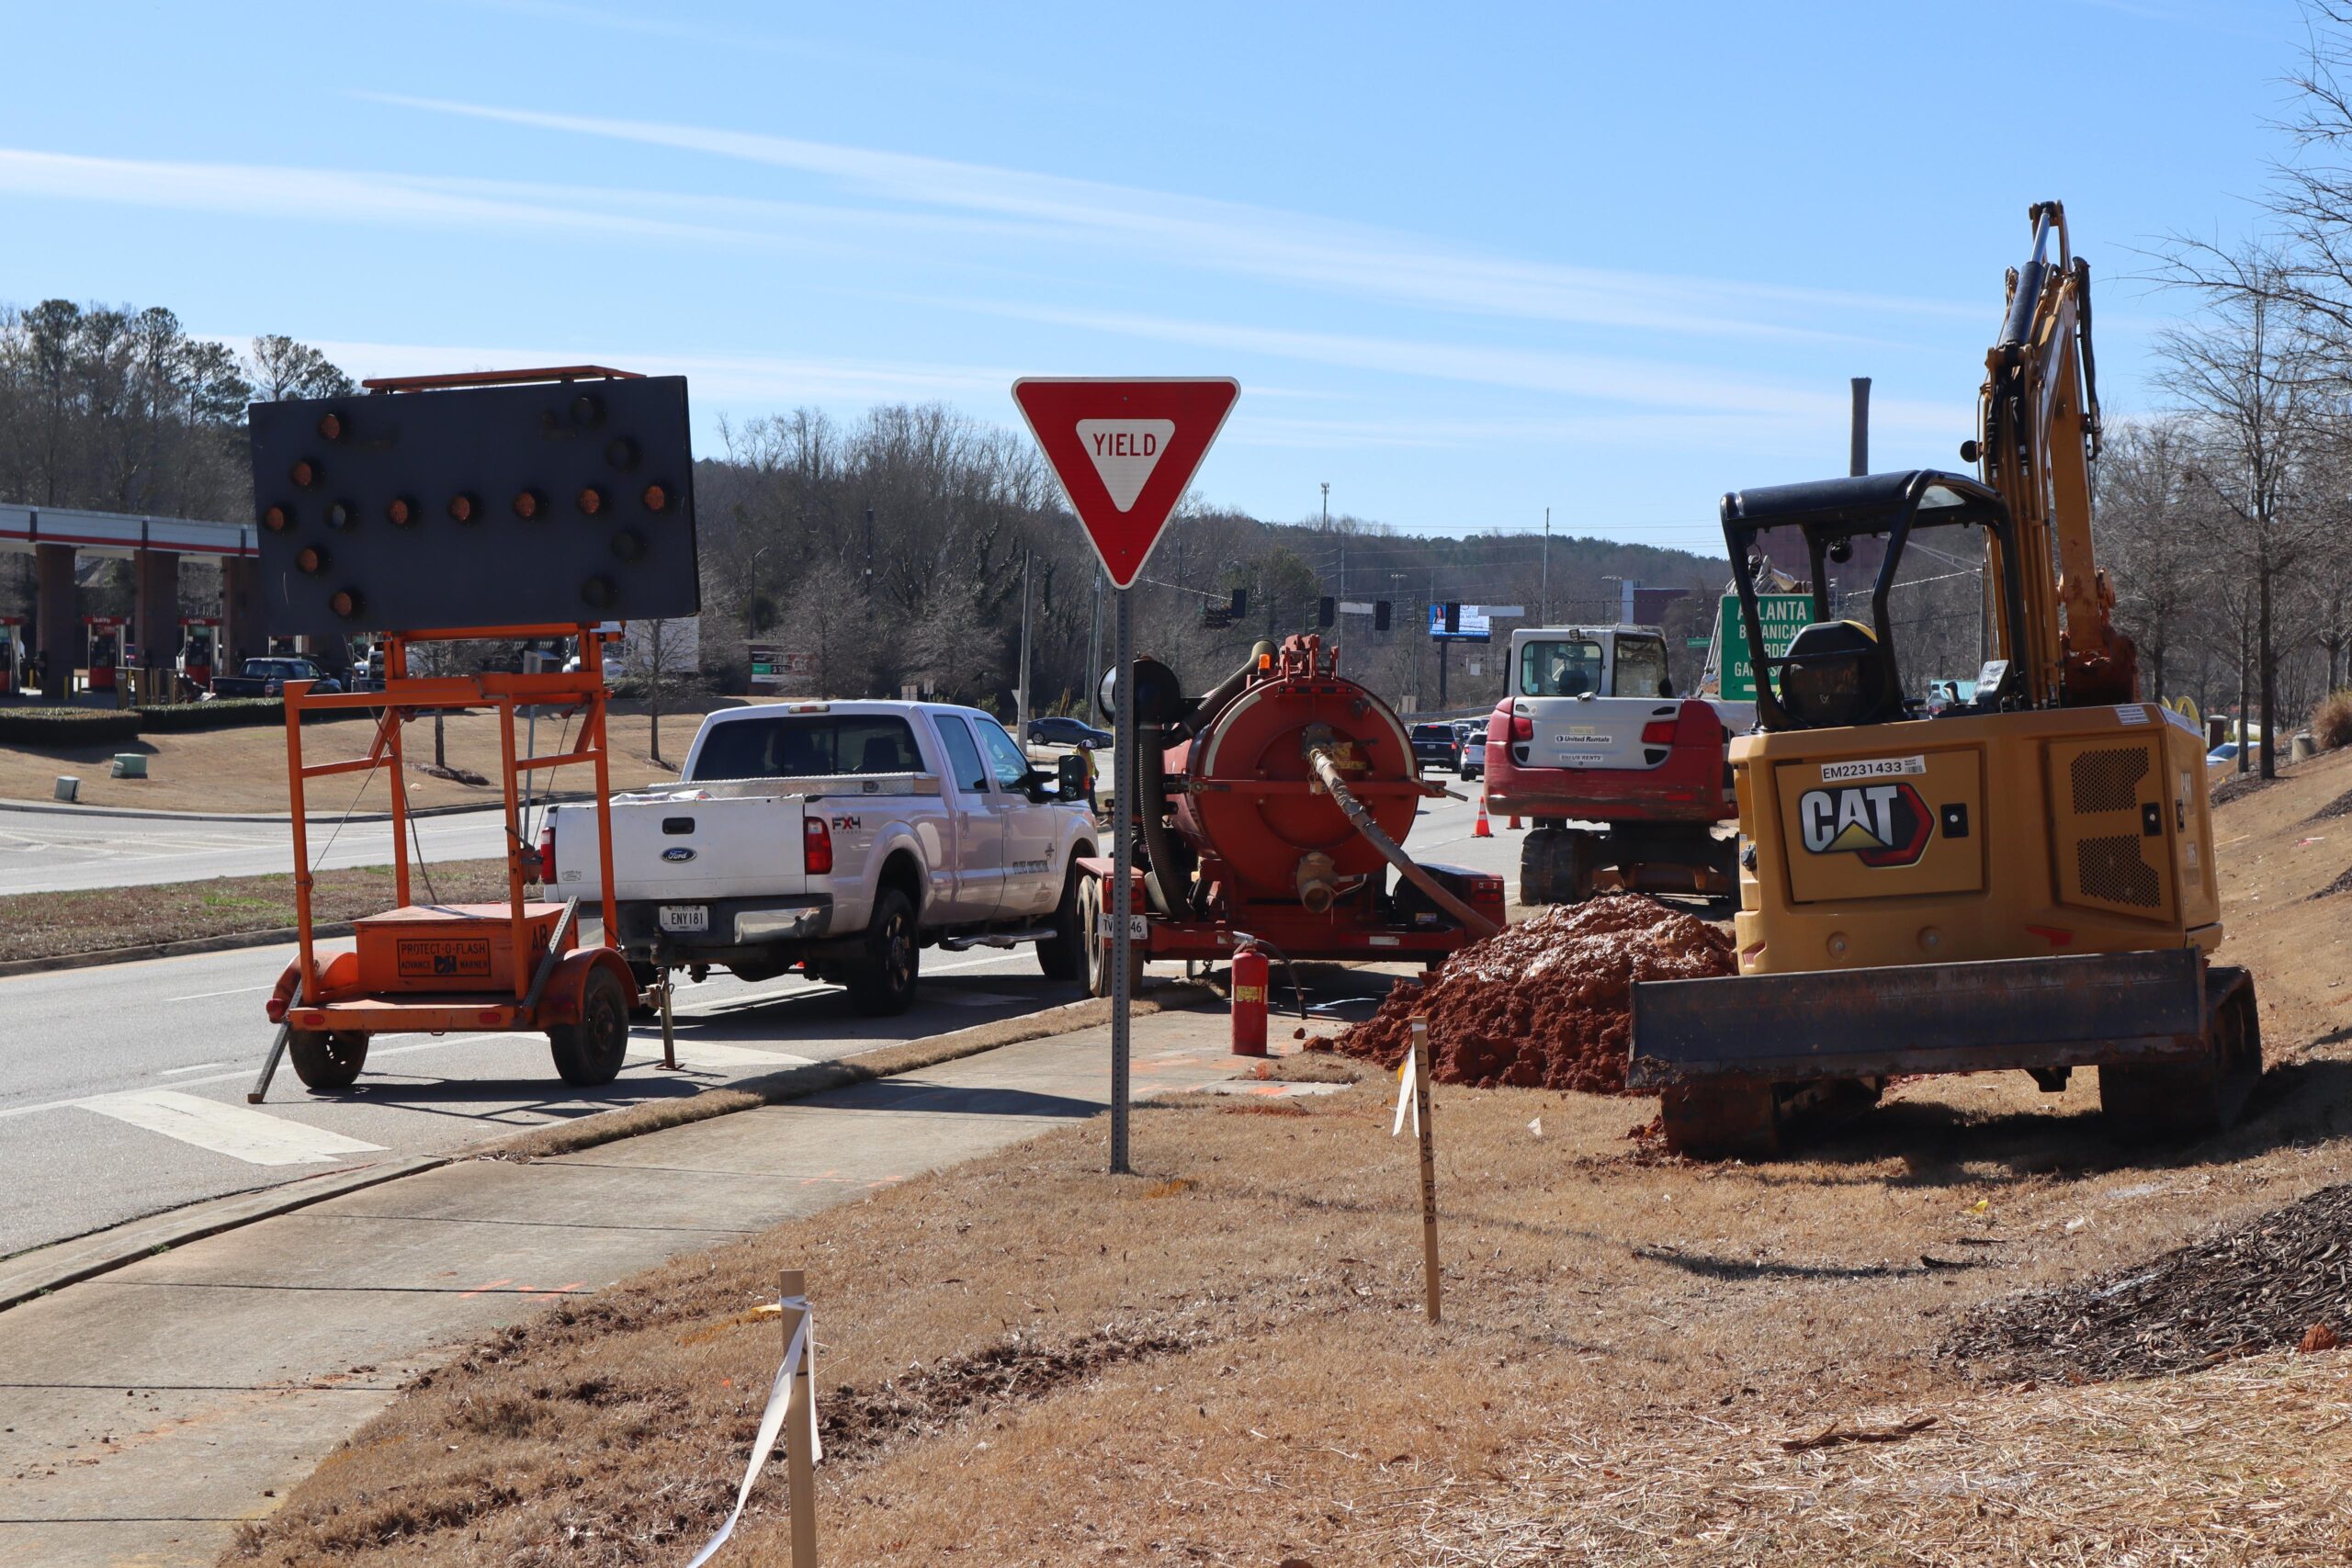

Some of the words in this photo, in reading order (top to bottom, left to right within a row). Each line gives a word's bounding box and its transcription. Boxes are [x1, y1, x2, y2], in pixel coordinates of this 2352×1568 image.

[1092, 433, 1157, 457] YIELD
[1737, 602, 1807, 621] ALANTA
[1823, 761, 1902, 779] EM2231433
[831, 816, 862, 830] FX4
[1801, 785, 1897, 852] CAT
[668, 849, 687, 860] Ford
[401, 942, 486, 954] PROTECT-O-FLASH
[401, 960, 432, 970] ADVANCE
